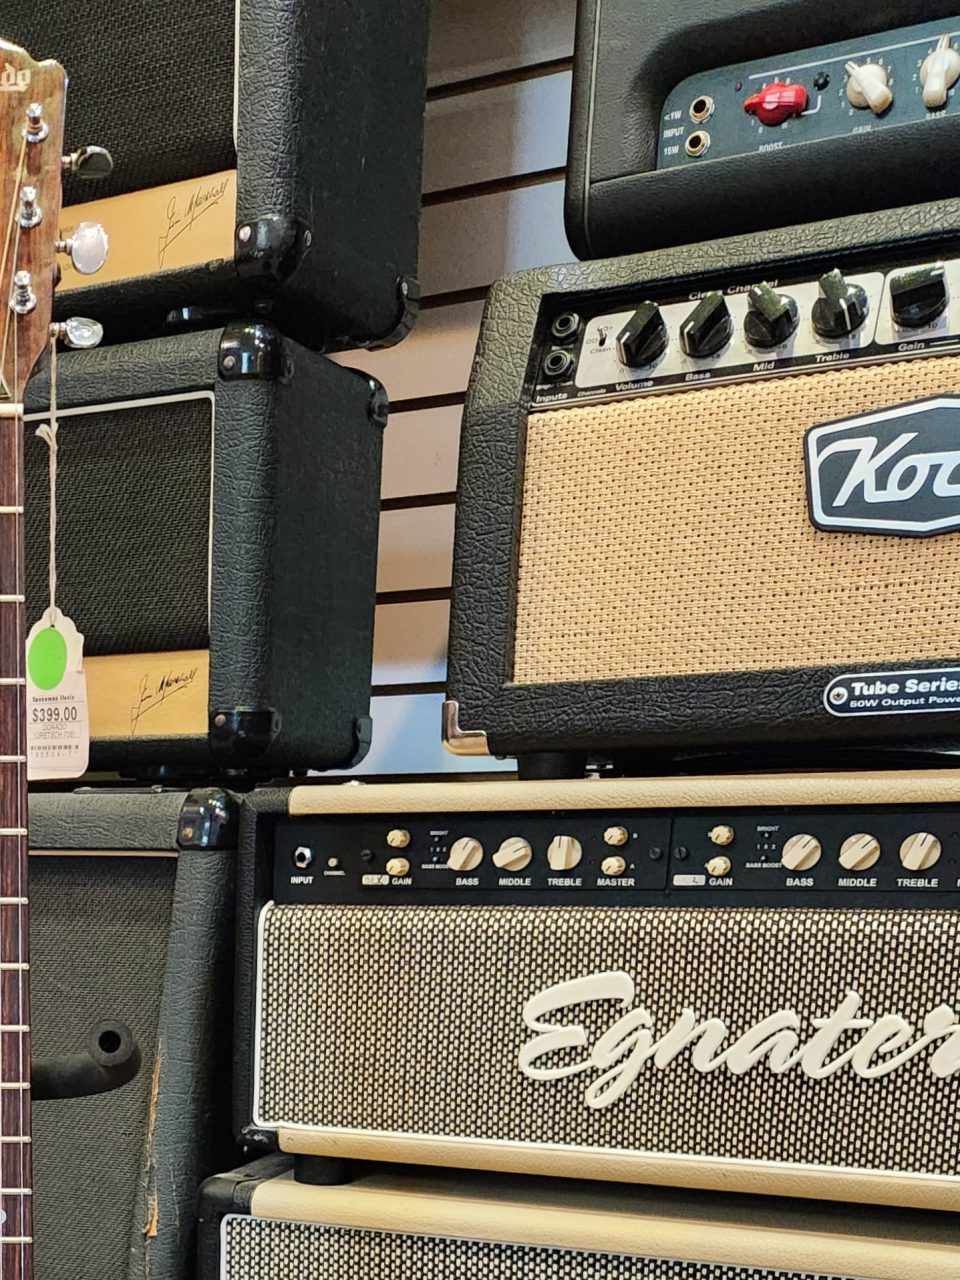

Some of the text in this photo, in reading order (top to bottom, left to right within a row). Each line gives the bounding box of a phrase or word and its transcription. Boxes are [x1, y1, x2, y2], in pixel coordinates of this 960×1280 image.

[663, 126, 685, 138] INPUT
[758, 141, 783, 152] BOOST
[726, 279, 779, 295] Chanel
[897, 341, 926, 352] Gain
[814, 351, 850, 364] Treble
[752, 361, 775, 372] Mid
[685, 371, 711, 381] Bass
[615, 380, 654, 392] Volume
[535, 392, 568, 403] Inputs
[851, 681, 900, 696] Tube
[849, 699, 879, 708] 50W
[881, 697, 925, 707] Output
[32, 706, 78, 723] $399.00
[290, 876, 314, 884] INPUT
[391, 877, 413, 886] GAIN
[455, 877, 480, 887] BASS
[498, 877, 532, 887] MIDDLE
[547, 877, 582, 887] TREBLE
[597, 877, 635, 887] MASTER
[708, 877, 733, 886] GAIN
[785, 877, 814, 887] BASS
[838, 878, 878, 887] MIDDLE
[896, 878, 939, 888] TREBLE
